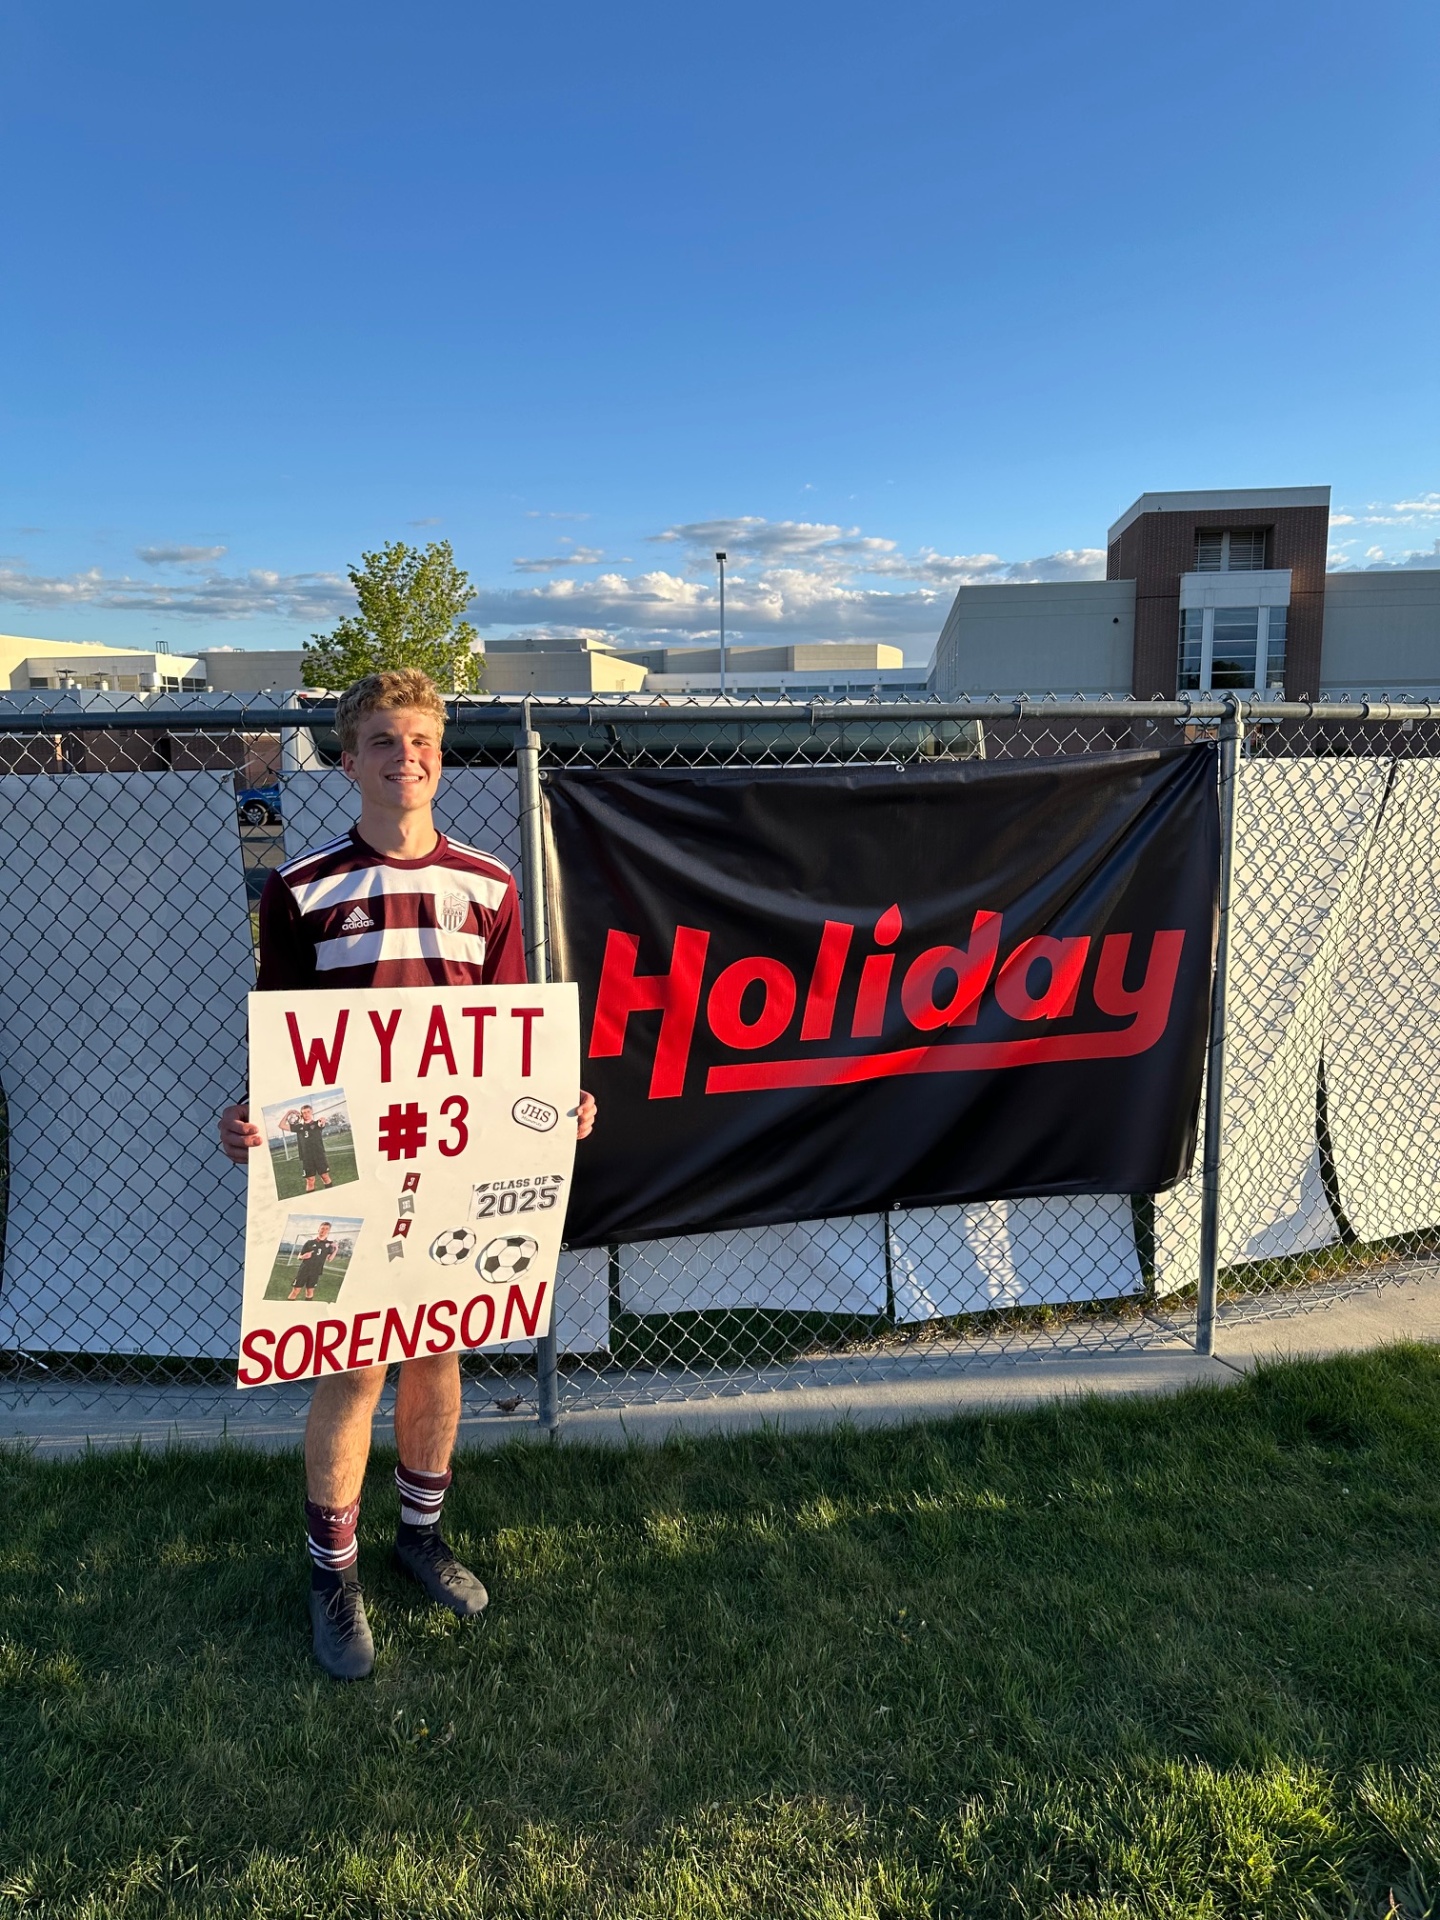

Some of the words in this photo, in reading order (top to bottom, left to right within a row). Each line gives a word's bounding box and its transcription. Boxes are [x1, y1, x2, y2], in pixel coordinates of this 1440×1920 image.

[341, 919, 375, 931] adidas
[588, 903, 1186, 1099] Holiday
[285, 1005, 544, 1087] WYATT
[521, 1104, 551, 1123] JHS
[304, 1130, 310, 1138] 3
[378, 1095, 469, 1161] #3
[492, 1178, 530, 1191] CLASS
[534, 1176, 549, 1186] OF
[476, 1185, 559, 1220] 2025
[316, 1248, 322, 1256] 3
[238, 1281, 547, 1386] SORENSON
